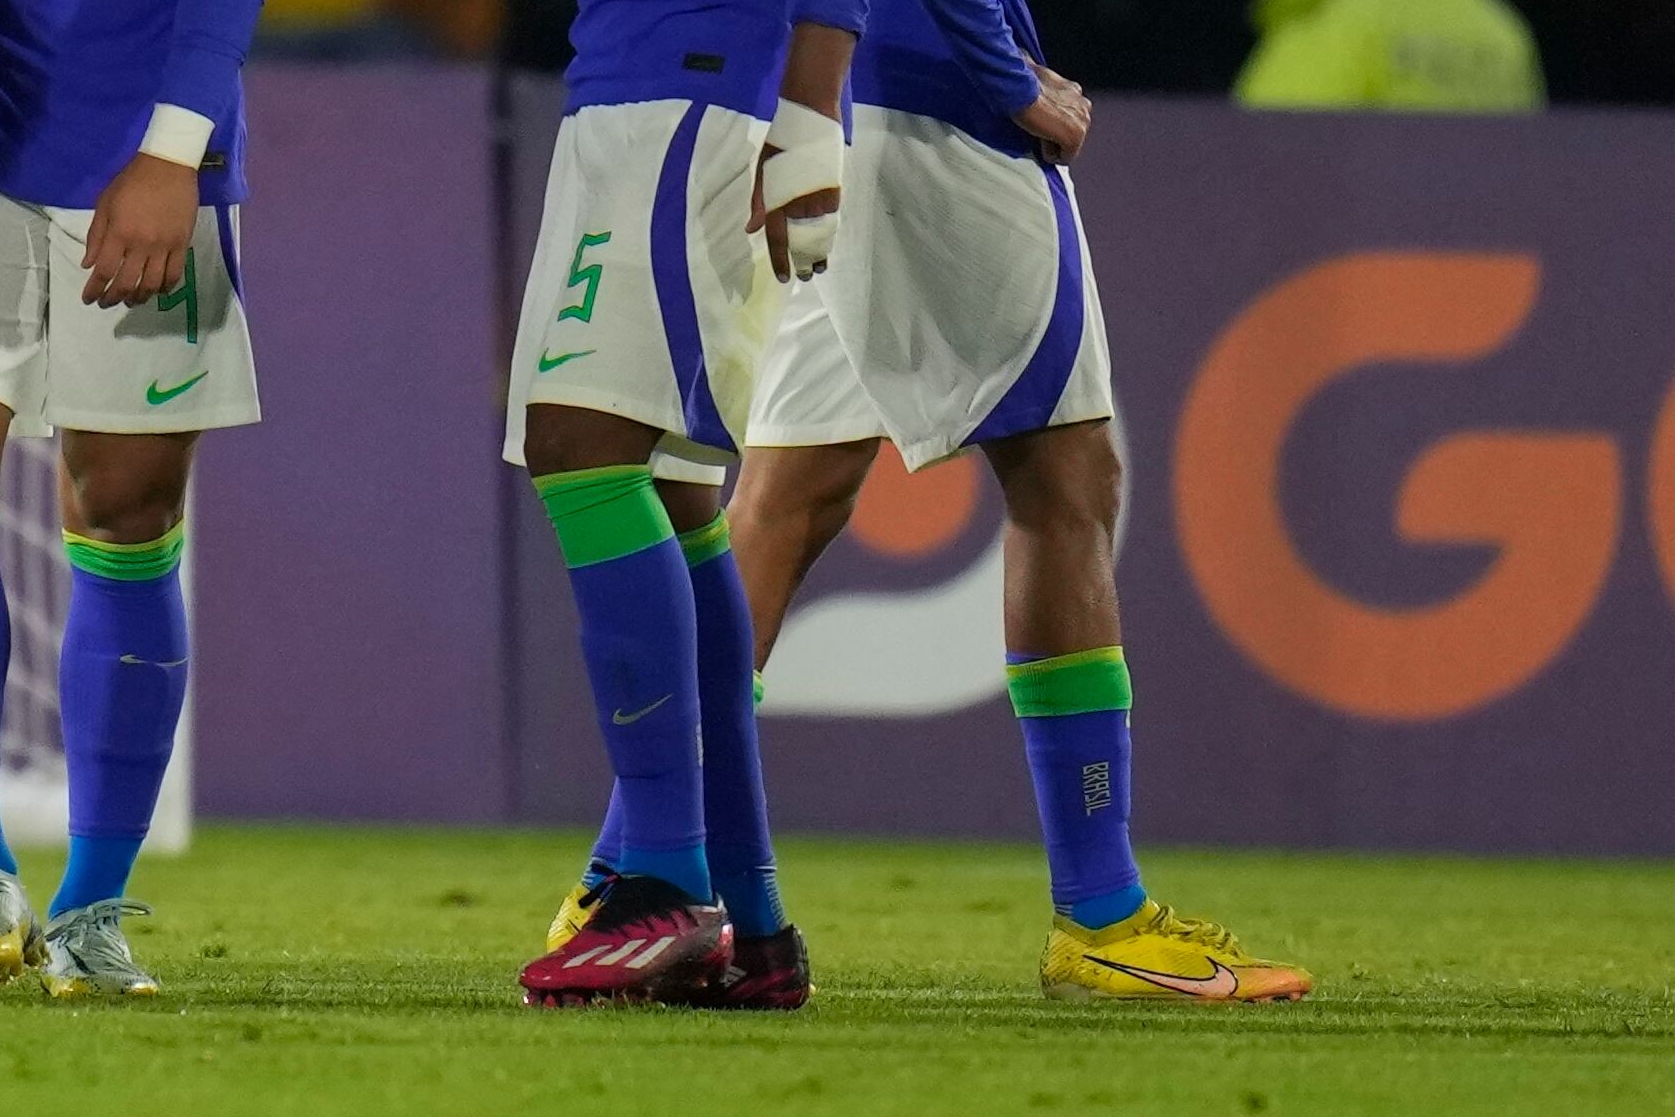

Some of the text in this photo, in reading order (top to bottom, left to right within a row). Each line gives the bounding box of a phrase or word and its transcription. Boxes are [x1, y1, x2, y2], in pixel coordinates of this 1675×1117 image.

[557, 230, 612, 323] 5
[1173, 250, 1675, 722] G
[1083, 761, 1112, 816] BRASIL
